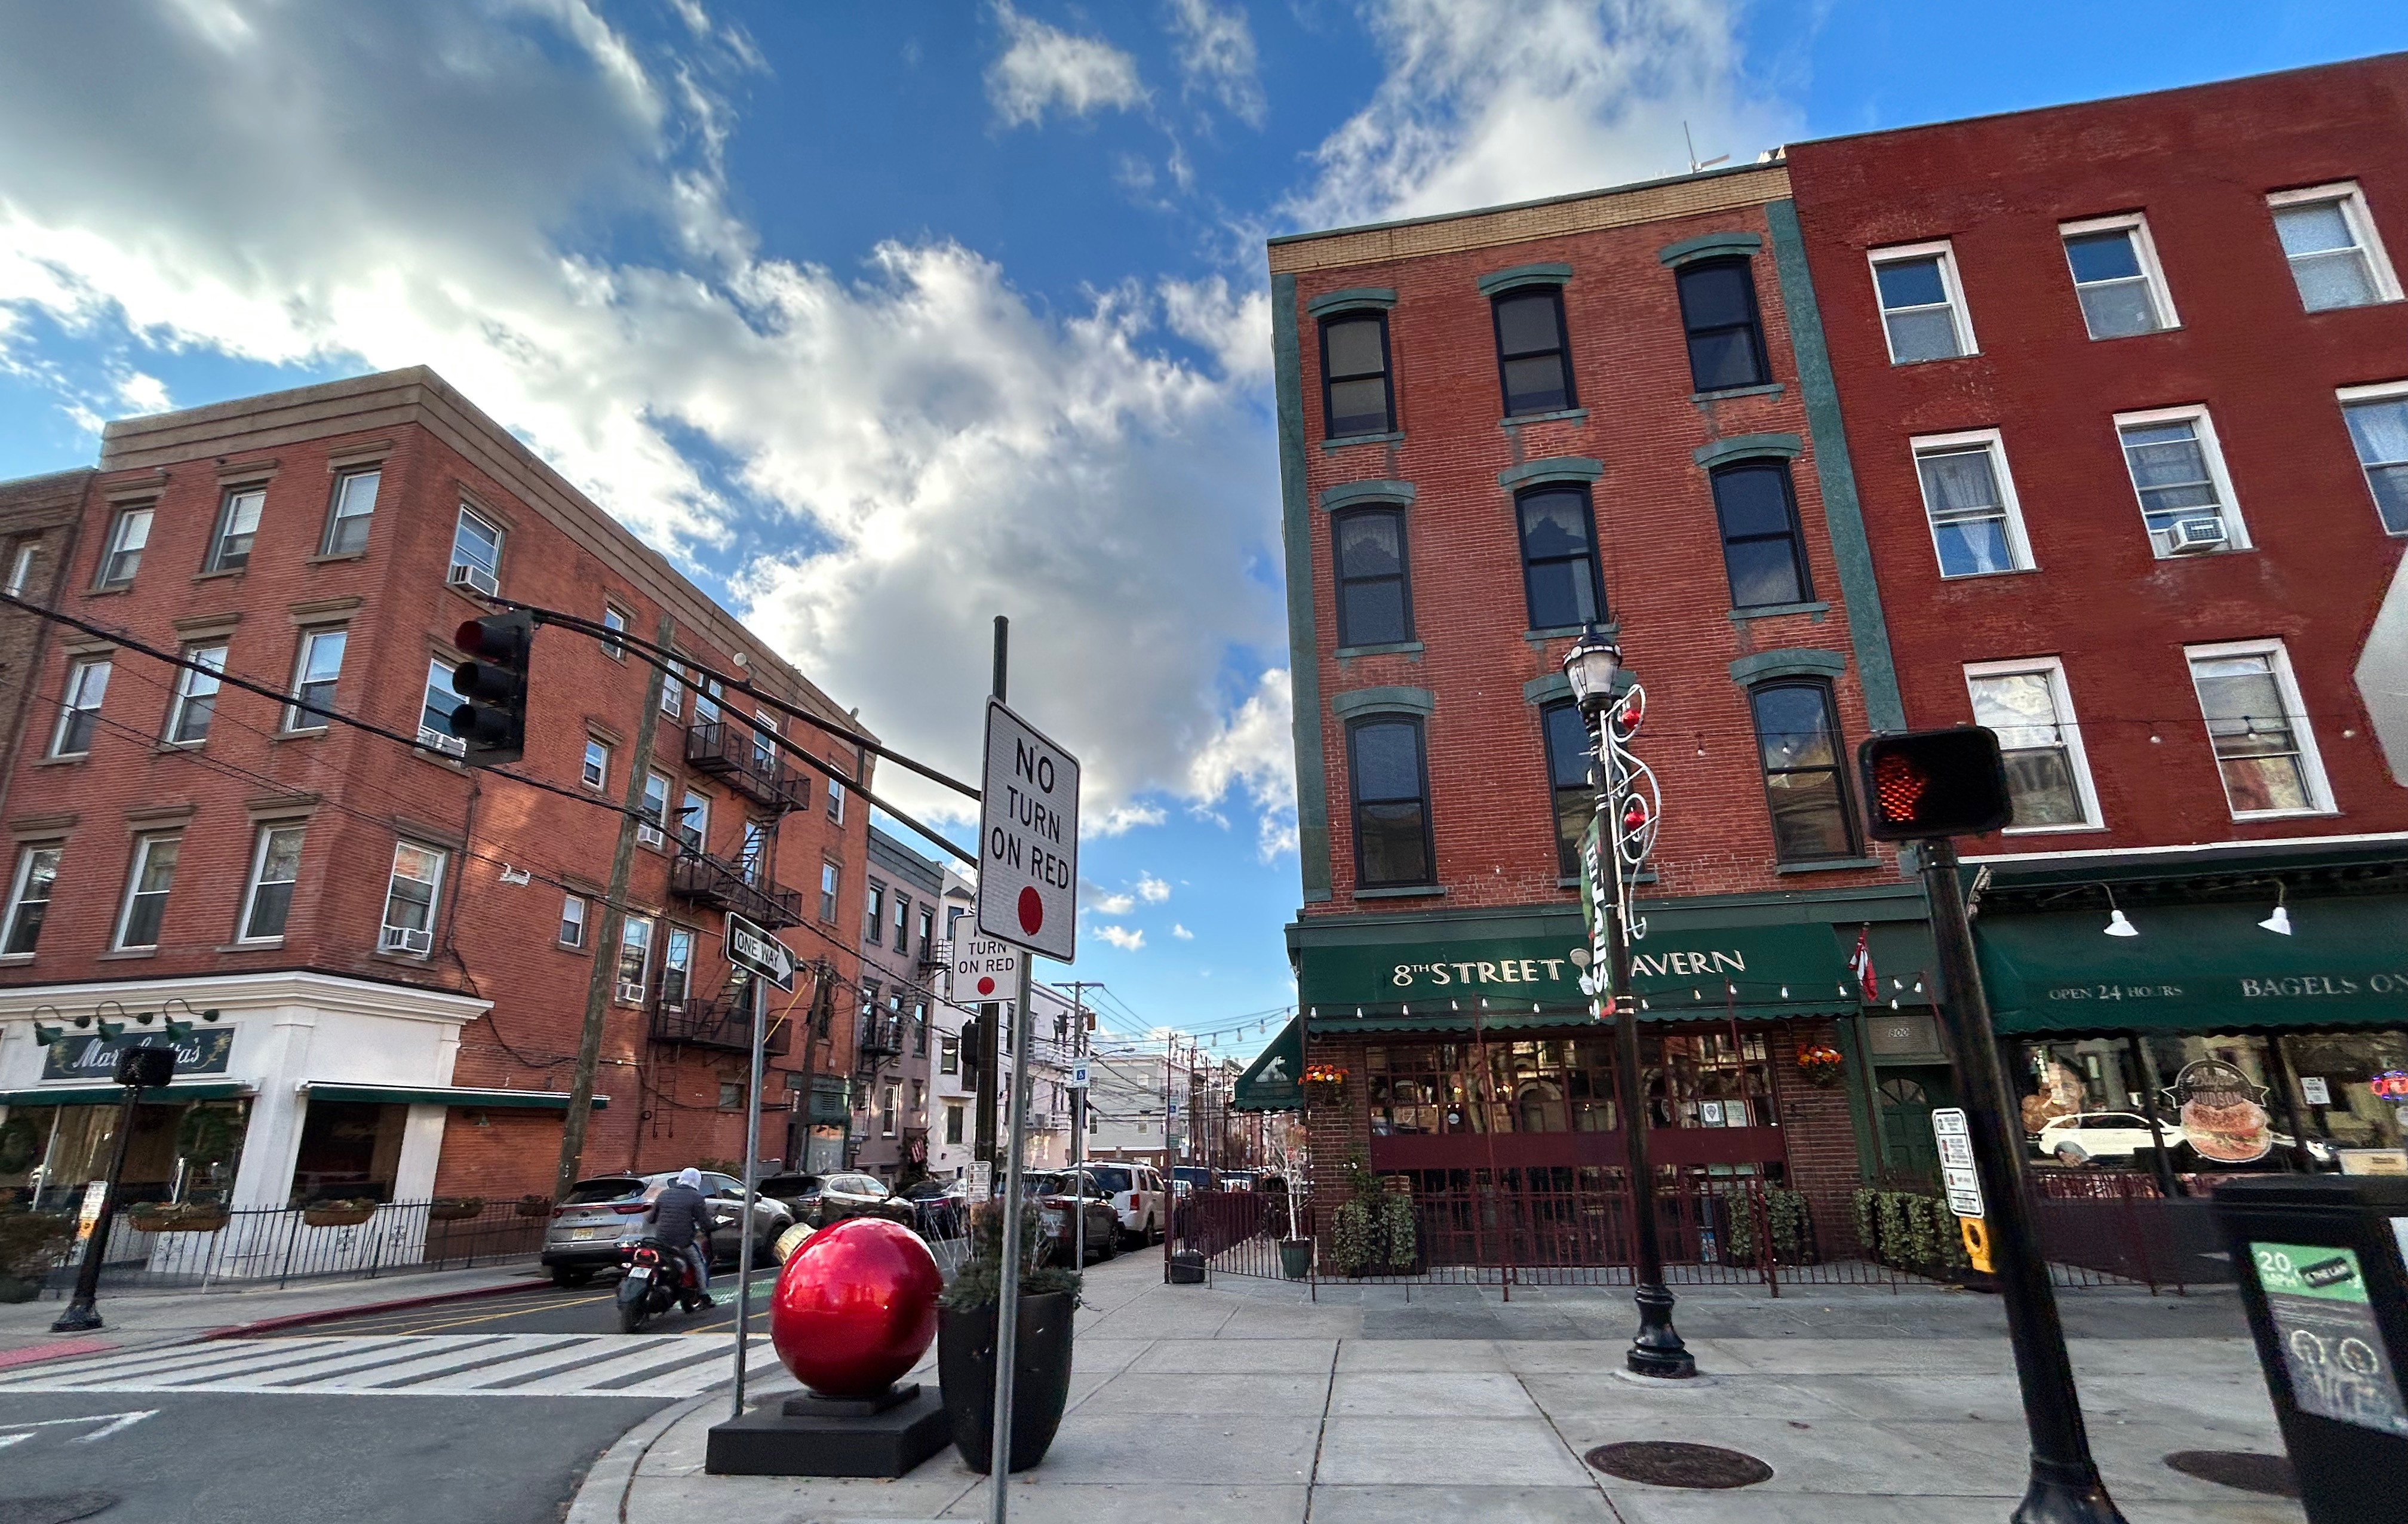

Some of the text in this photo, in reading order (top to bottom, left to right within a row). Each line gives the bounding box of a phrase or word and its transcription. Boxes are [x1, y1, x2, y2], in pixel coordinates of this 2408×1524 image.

[1016, 738, 1054, 794] NO
[1007, 784, 1060, 844] TURN
[991, 826, 1068, 889] ON RED
[738, 932, 779, 967] ONE WAY
[968, 941, 1006, 955] TURN
[959, 958, 1014, 974] ON RED
[1393, 950, 1745, 986] 8TH STREET AVERN
[2049, 988, 2092, 1000] OPEN
[2099, 985, 2121, 1000] 24
[2241, 976, 2358, 997] BAGELS
[2258, 1251, 2291, 1273] 20
